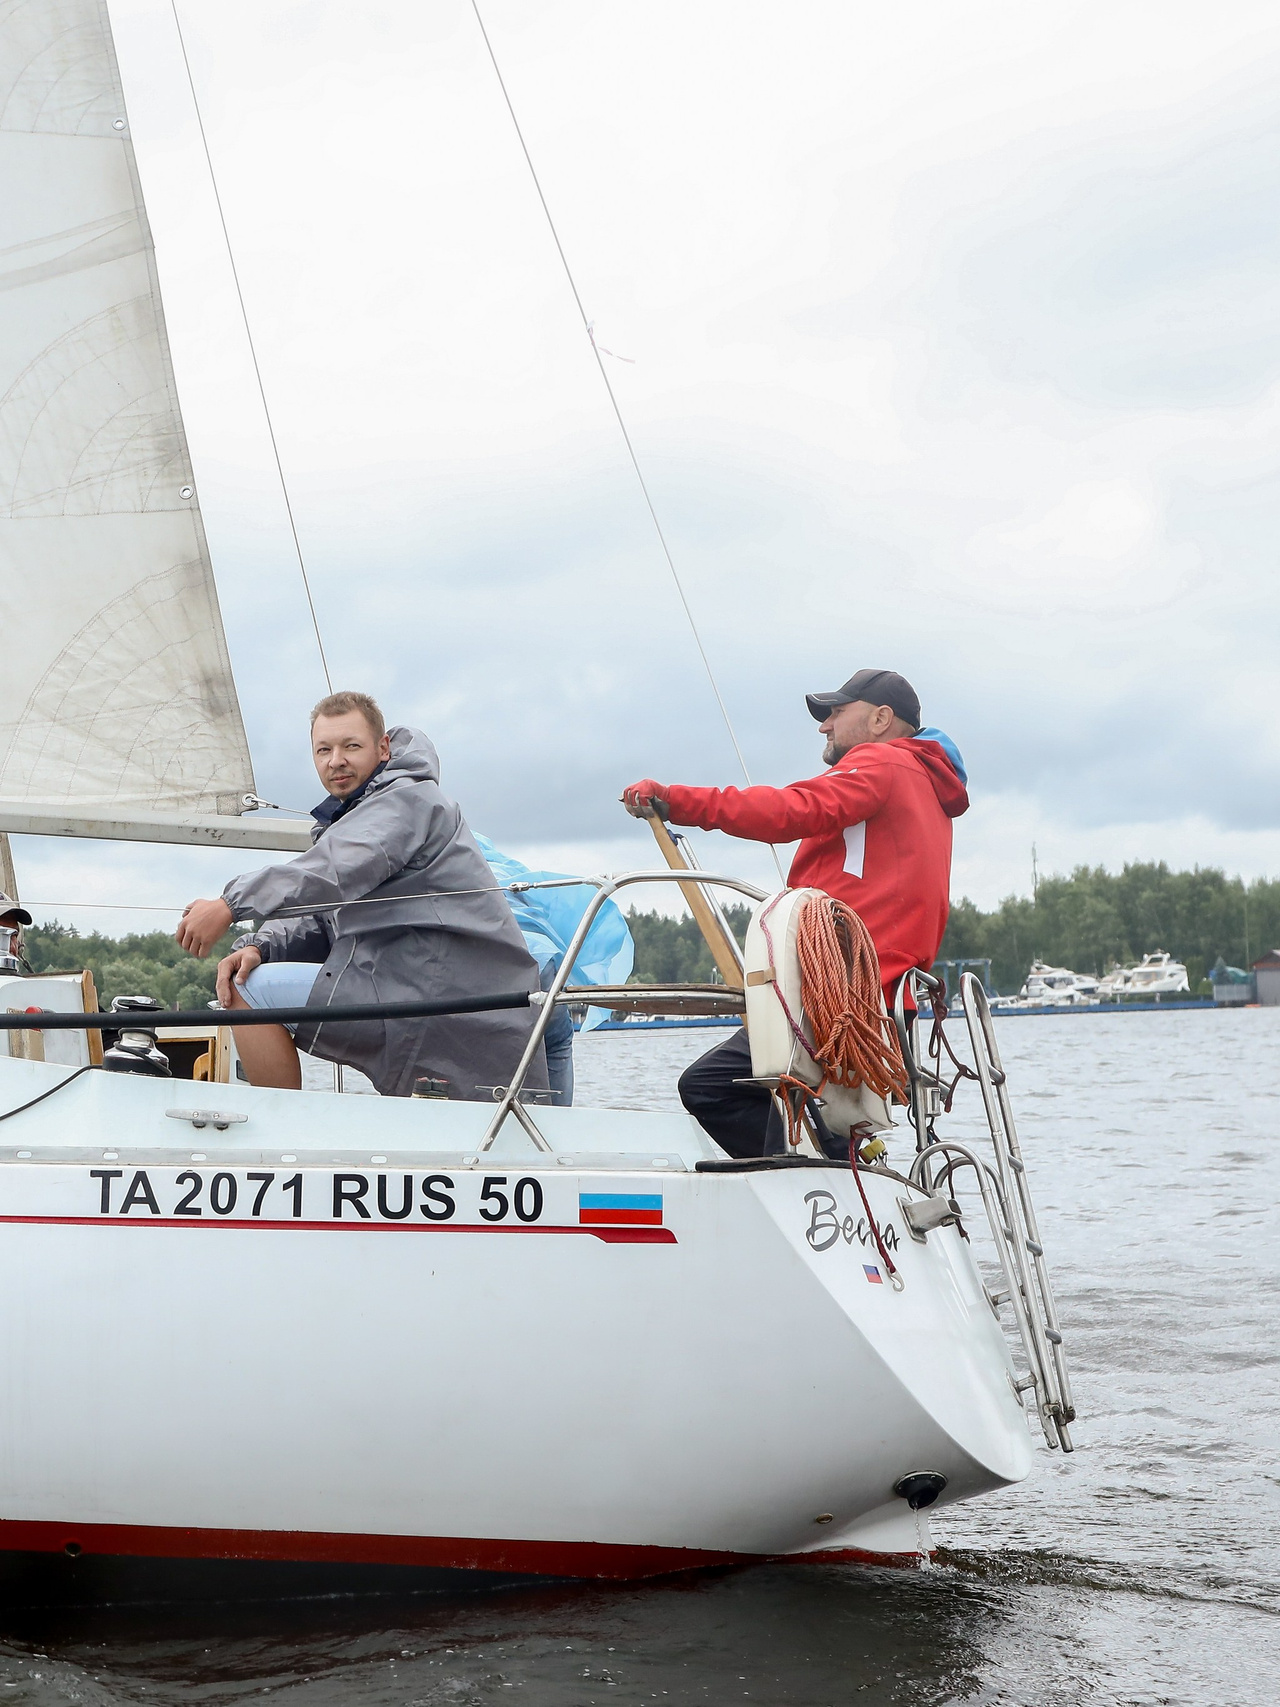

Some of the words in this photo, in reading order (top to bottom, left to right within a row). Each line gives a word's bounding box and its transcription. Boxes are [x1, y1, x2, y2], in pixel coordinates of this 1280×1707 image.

[89, 1169, 161, 1215] TA
[173, 1171, 303, 1218] 2071
[332, 1173, 456, 1221] RUS
[478, 1176, 544, 1223] 50
